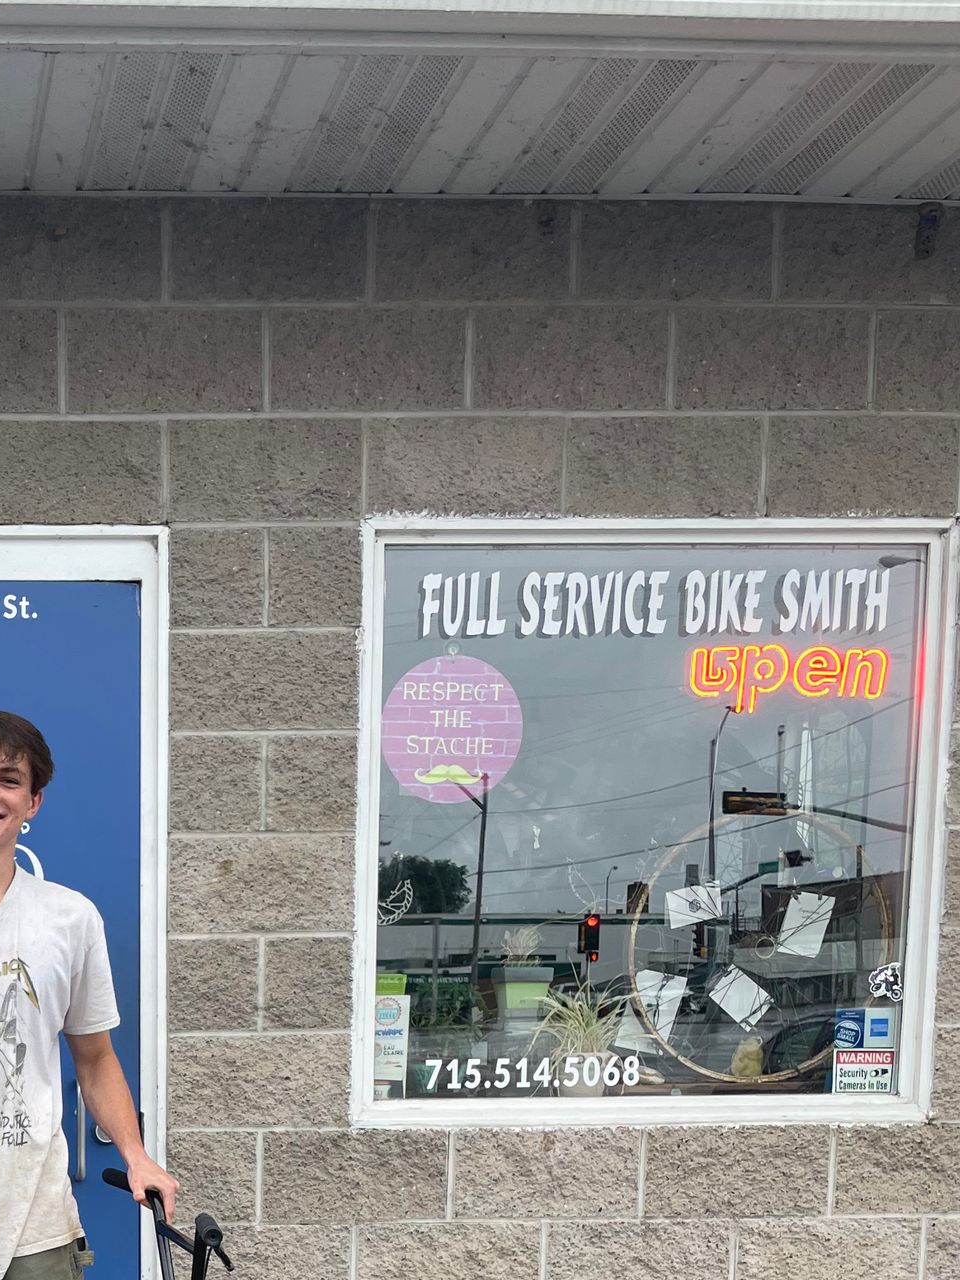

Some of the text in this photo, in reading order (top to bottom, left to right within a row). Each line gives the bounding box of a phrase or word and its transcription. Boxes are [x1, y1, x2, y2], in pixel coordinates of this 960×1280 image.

[2, 594, 38, 620] St.
[421, 568, 891, 637] FULL SERVICE BIKE SMITH
[403, 681, 504, 702] RESPECT
[431, 709, 472, 729] THE
[406, 736, 494, 756] STACHE
[836, 1033, 856, 1043] SMALL
[839, 1028, 856, 1037] SHOP
[838, 1052, 892, 1064] WARNING
[425, 1055, 640, 1091] 715.514.5068
[839, 1067, 868, 1080] Security
[838, 1080, 867, 1091] Cameras
[876, 1080, 888, 1090] Use
